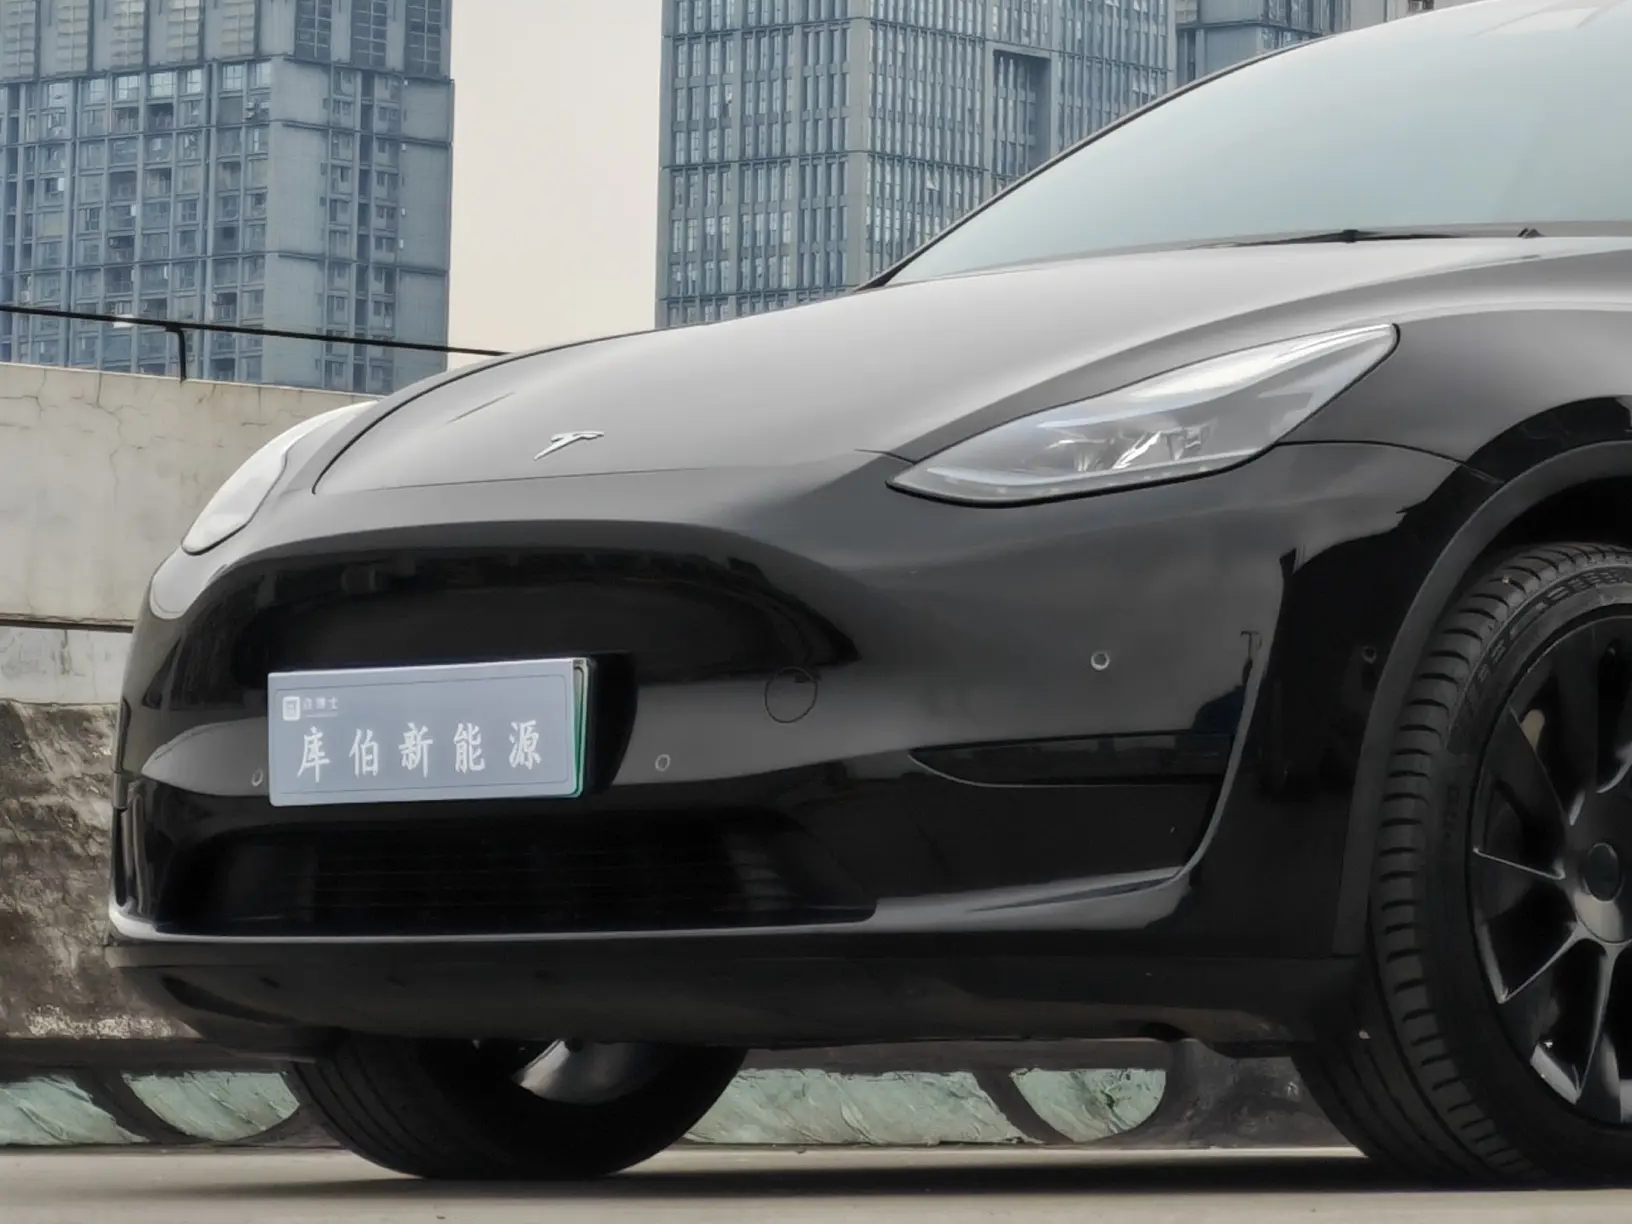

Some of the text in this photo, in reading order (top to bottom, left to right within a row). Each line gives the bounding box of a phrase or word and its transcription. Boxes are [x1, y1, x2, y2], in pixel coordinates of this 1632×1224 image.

[297, 719, 542, 783] 库伯新能源
